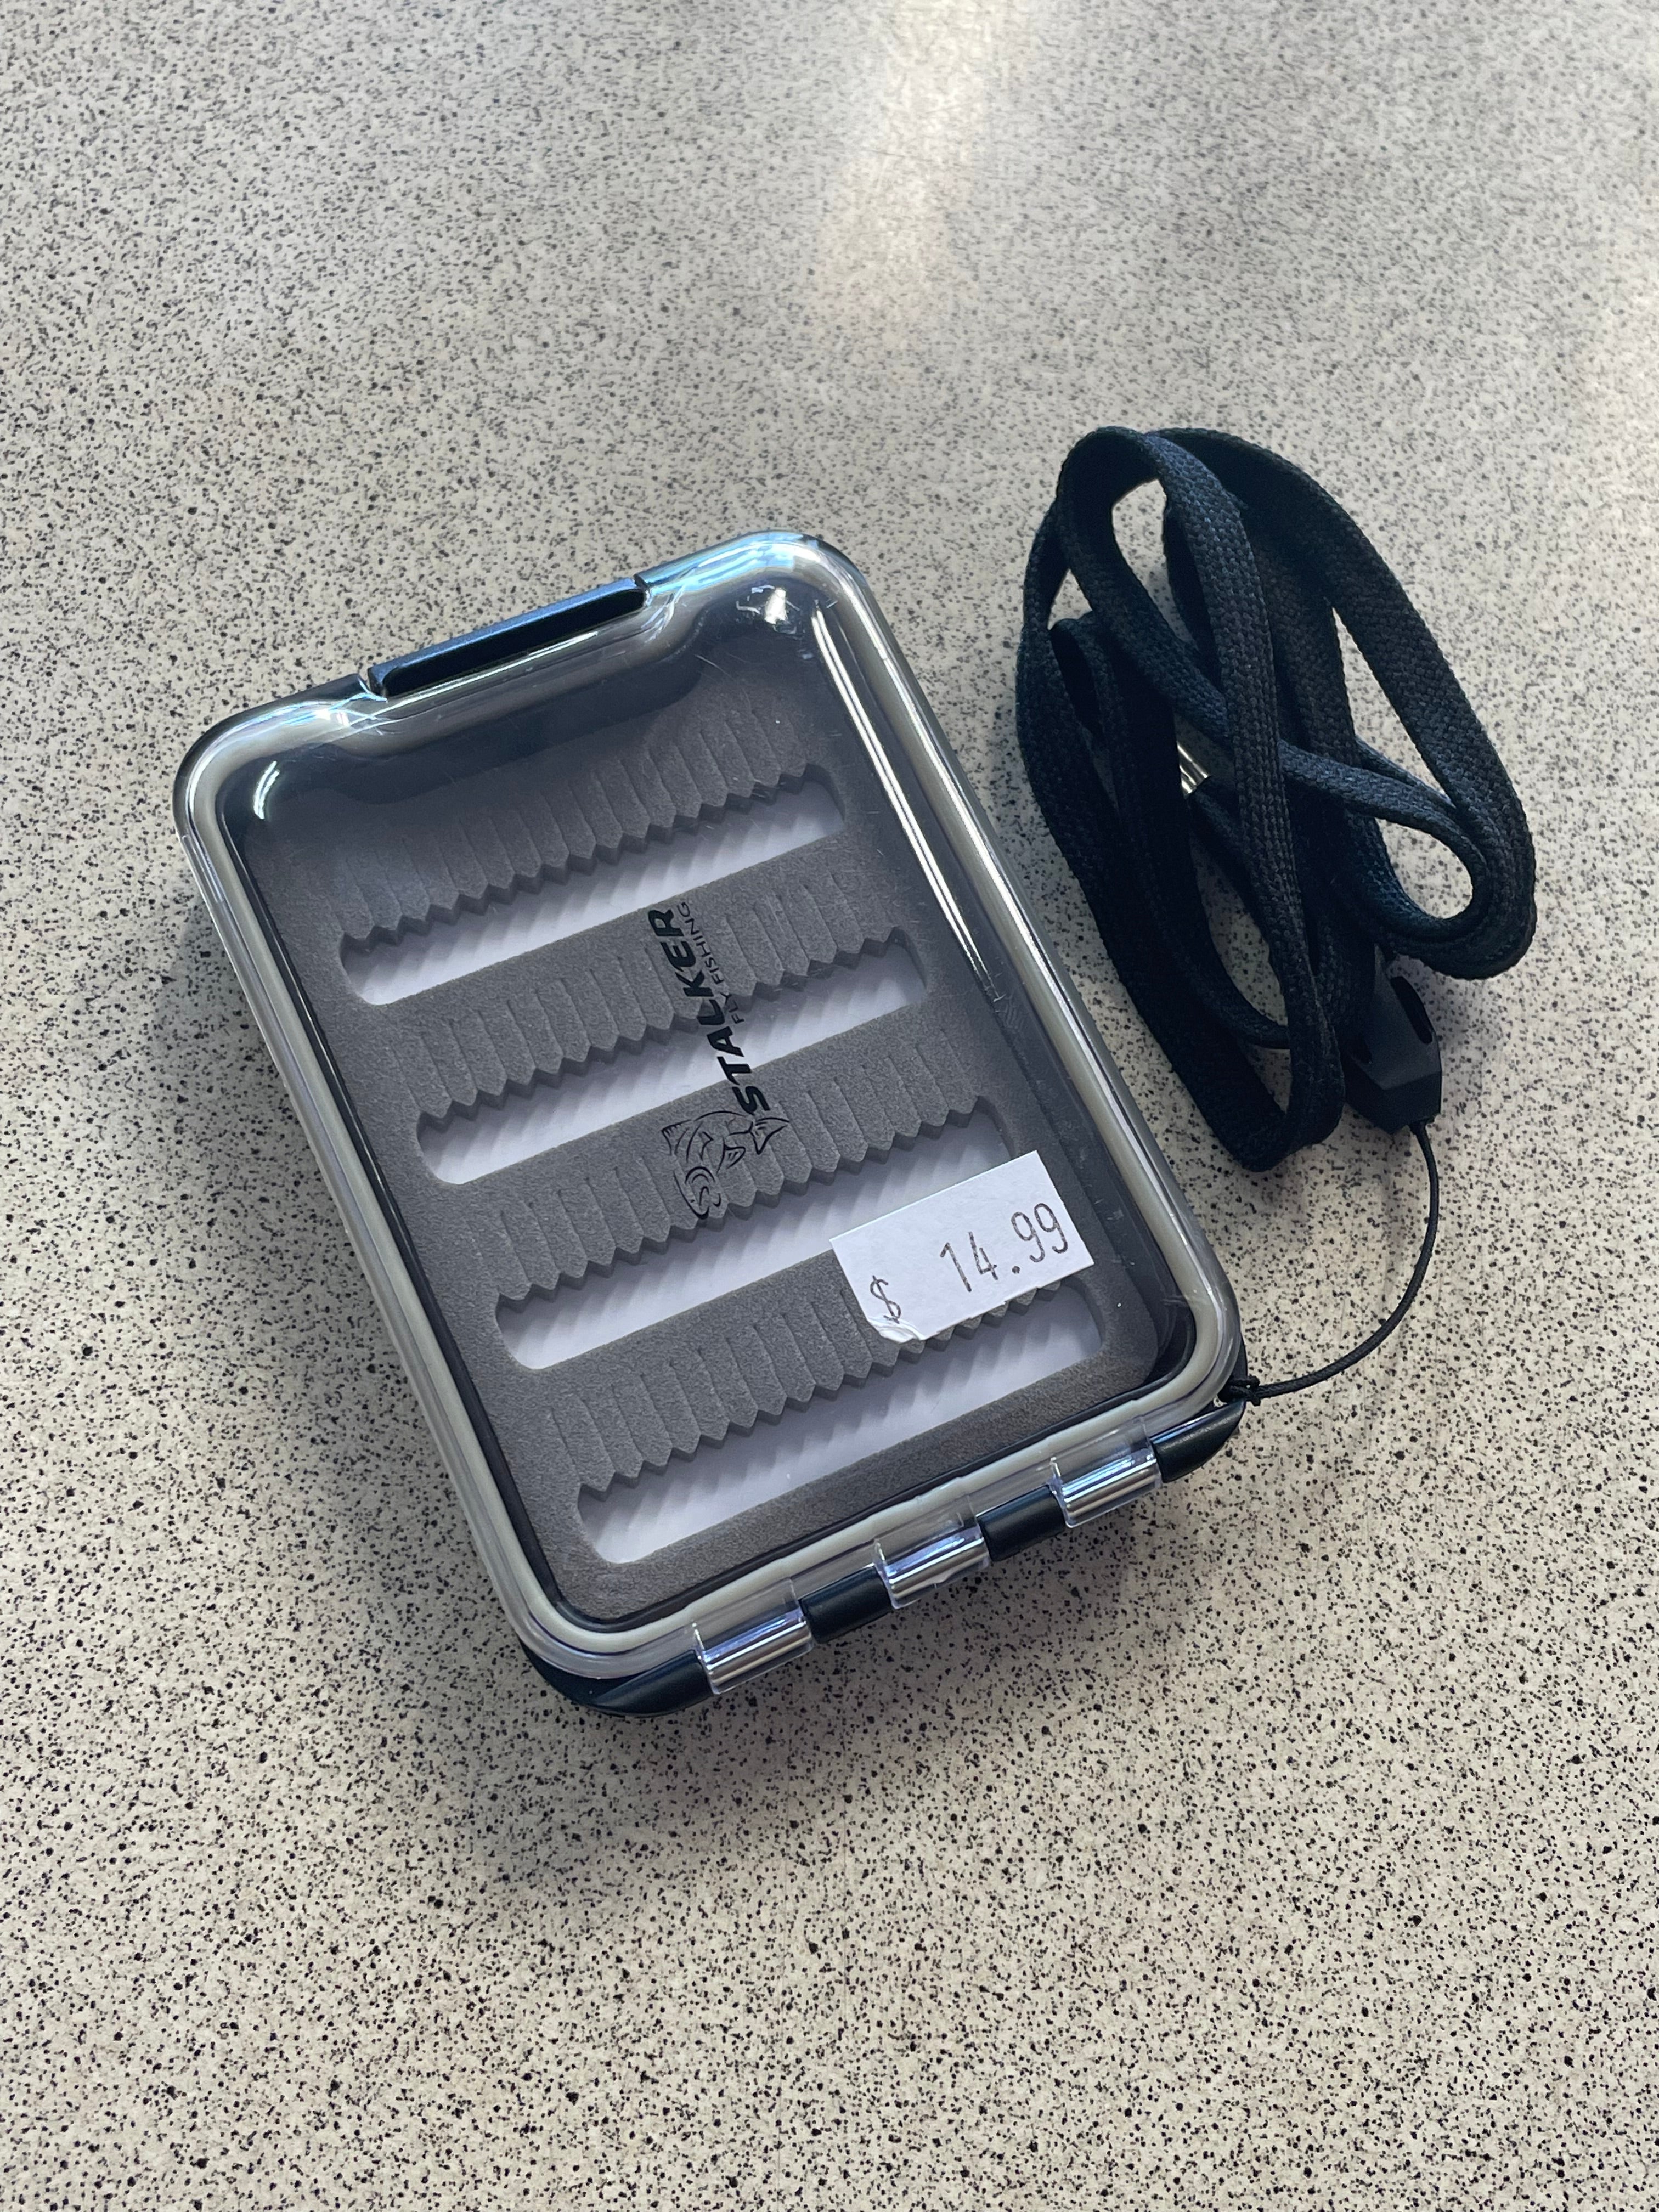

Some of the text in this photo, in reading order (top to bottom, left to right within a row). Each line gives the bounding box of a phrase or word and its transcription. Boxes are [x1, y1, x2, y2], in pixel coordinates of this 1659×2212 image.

[648, 909, 770, 1115] STALKER
[677, 902, 744, 1024] FLY FISHING
[870, 1203, 1068, 1324] $ 14.99
